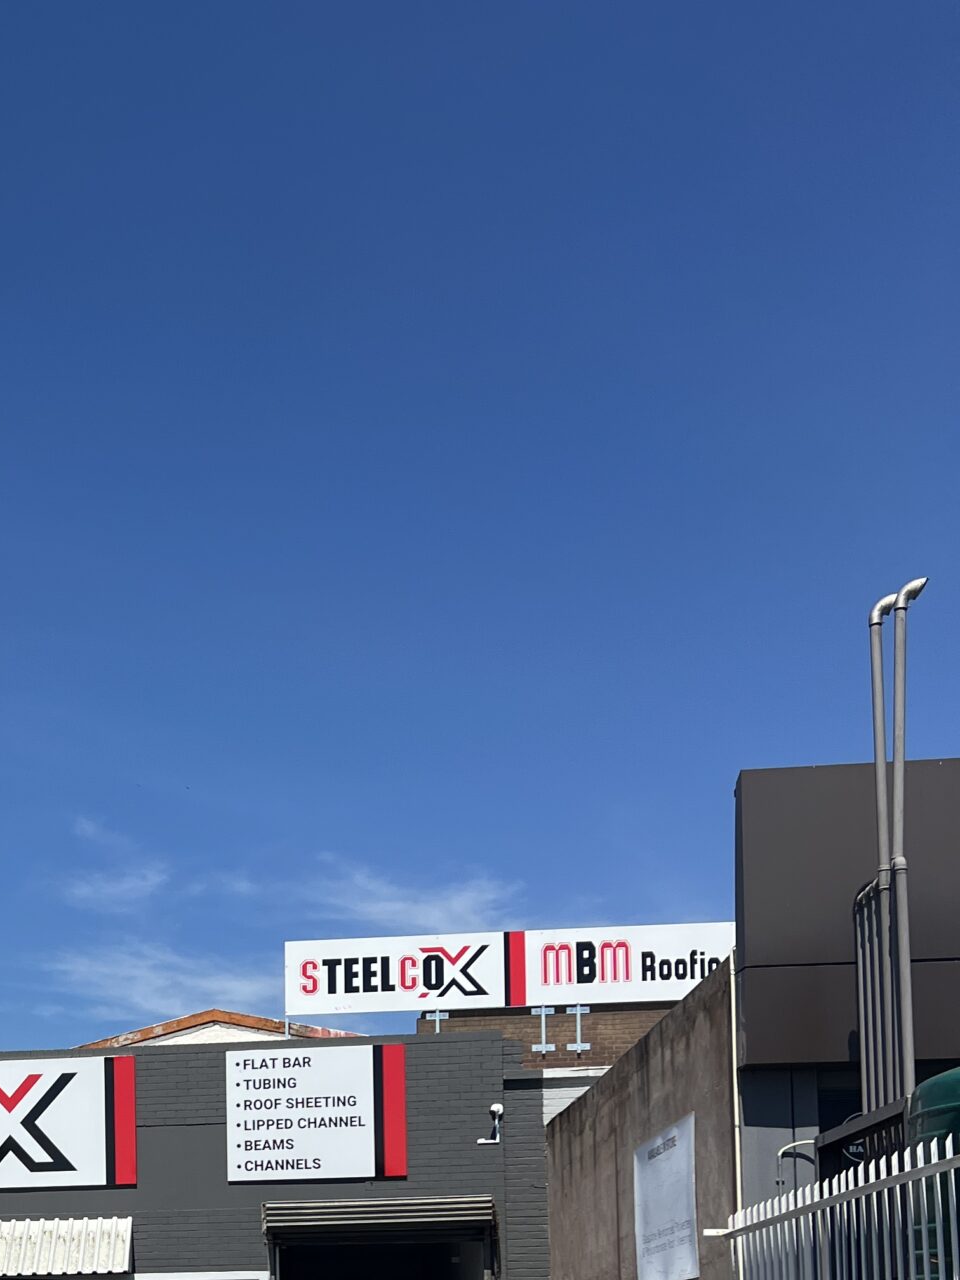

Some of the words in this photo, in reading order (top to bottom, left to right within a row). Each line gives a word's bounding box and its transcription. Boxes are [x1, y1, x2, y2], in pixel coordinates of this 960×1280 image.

[243, 1058, 278, 1070] FLAT
[282, 1056, 312, 1069] BAR
[243, 1077, 297, 1090] TUBING
[243, 1098, 282, 1111] ROOF
[286, 1095, 357, 1109] SHEETING
[244, 1118, 293, 1131] LIPPED
[297, 1116, 366, 1129] CHANNEL
[244, 1138, 295, 1151] BEAMS
[244, 1158, 321, 1171] CHANNELS
